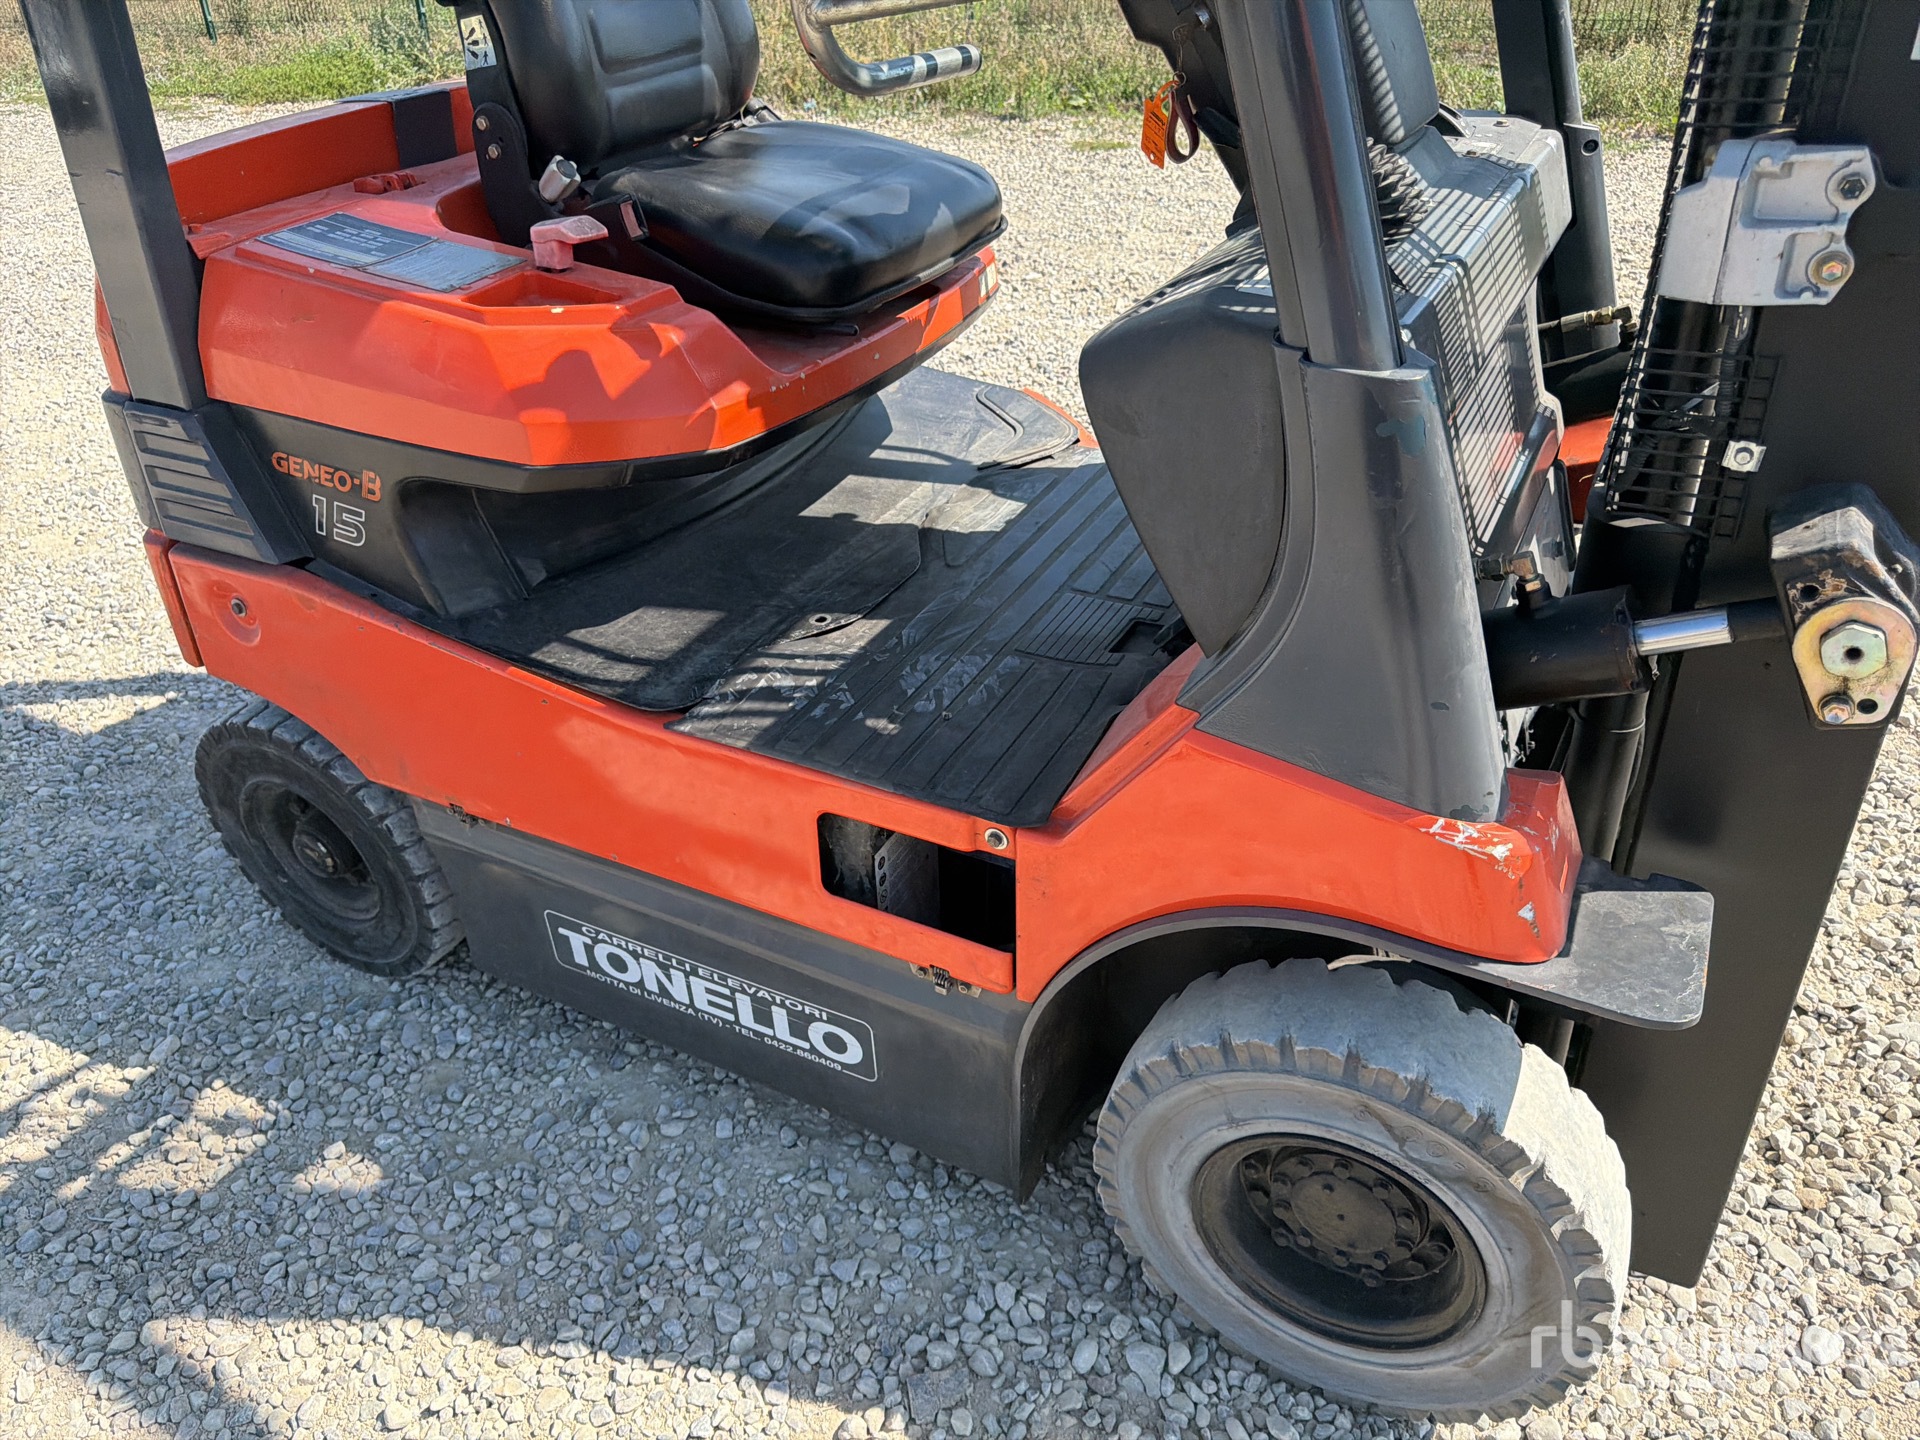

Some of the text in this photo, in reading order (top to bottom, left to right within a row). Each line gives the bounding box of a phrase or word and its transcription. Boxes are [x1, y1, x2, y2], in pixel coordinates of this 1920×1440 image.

[312, 493, 366, 547] 15
[558, 927, 863, 1065] TONELLO
[581, 926, 828, 1021] CARRELLI ELEVATORI
[585, 969, 628, 991] MOTTA
[629, 984, 642, 996] DI
[643, 991, 697, 1017] LIVENZA
[697, 1011, 723, 1027] (TV)
[732, 1024, 762, 1041] TEL.
